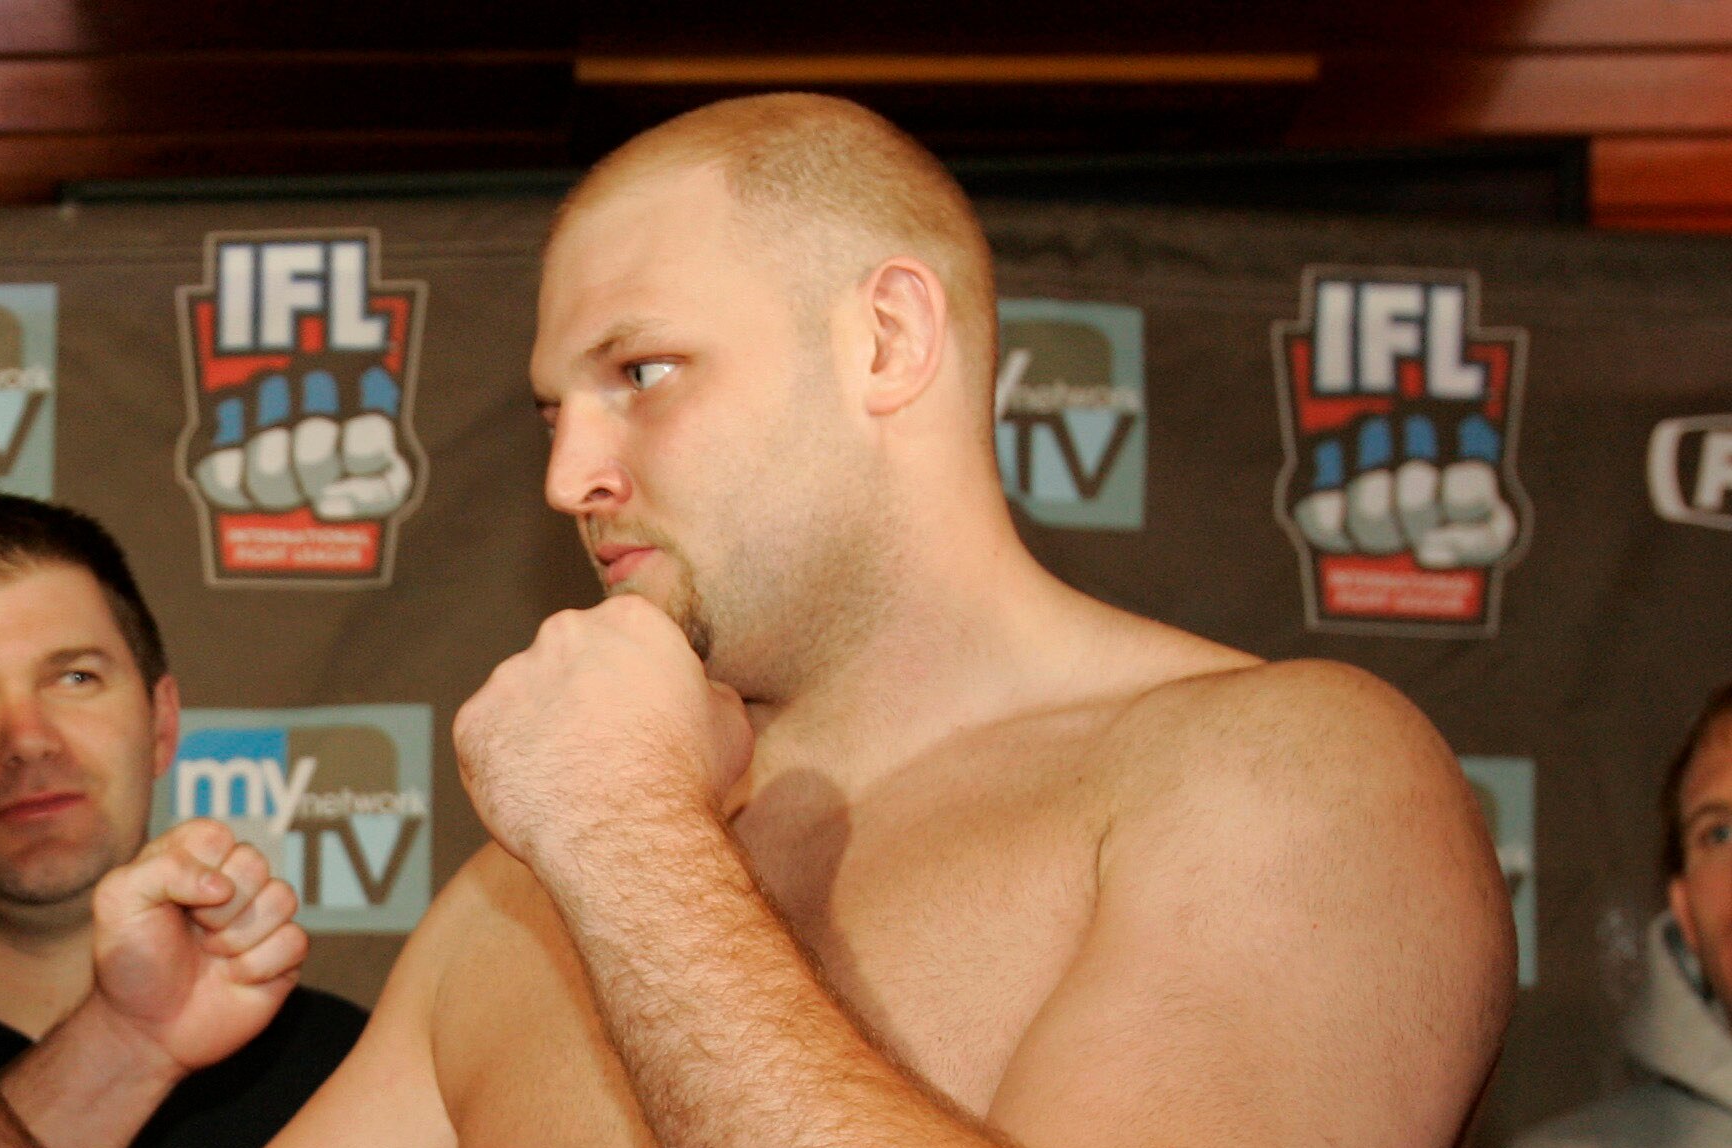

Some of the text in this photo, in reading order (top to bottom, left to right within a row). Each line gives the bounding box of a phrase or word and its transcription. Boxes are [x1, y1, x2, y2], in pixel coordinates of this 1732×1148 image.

[219, 241, 387, 350] IFL
[1316, 283, 1487, 398] IFL
[1000, 409, 1138, 500] TV
[176, 756, 316, 837] my
[287, 815, 423, 905] TV
